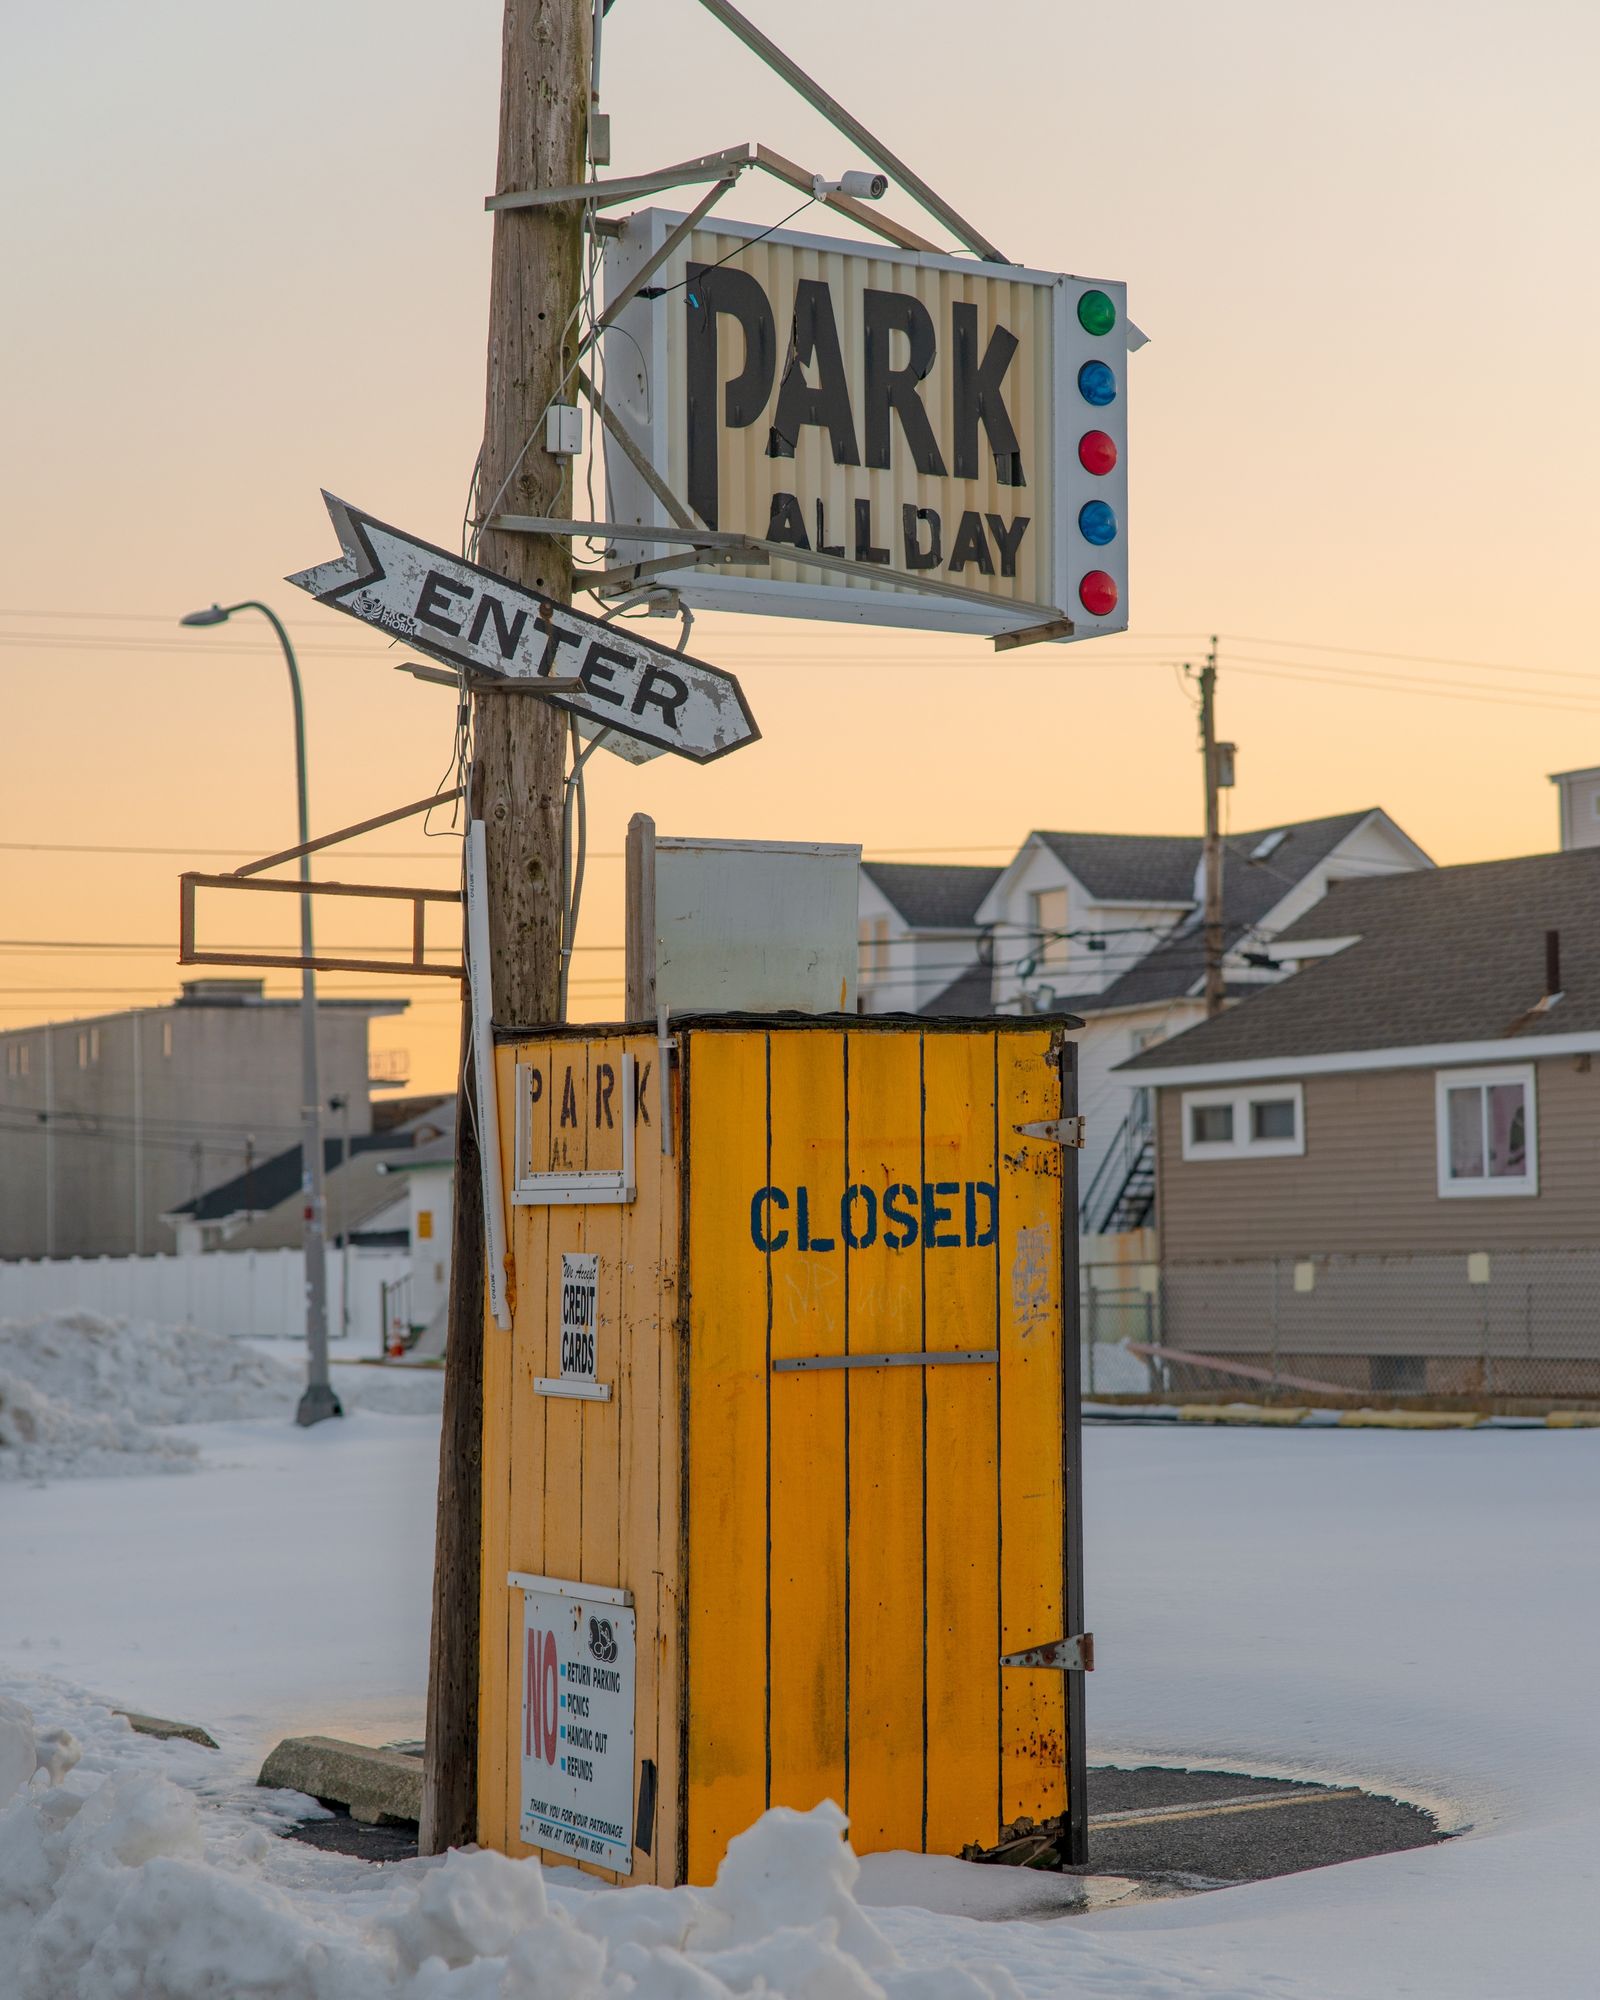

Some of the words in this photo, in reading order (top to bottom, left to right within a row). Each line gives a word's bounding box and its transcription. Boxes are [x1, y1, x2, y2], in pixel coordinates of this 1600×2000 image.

[686, 261, 1027, 531] PARK
[380, 614, 414, 636] PHOBIA
[414, 570, 689, 729] ENTER
[750, 1181, 998, 1252] CLOSED
[563, 1262, 574, 1279] We
[575, 1264, 597, 1284] Accept
[563, 1284, 596, 1327] CREDIT
[562, 1331, 594, 1375] CARDS
[567, 1661, 591, 1687] RETURN
[592, 1667, 621, 1693] PARKING
[525, 1627, 558, 1766] NO
[567, 1693, 590, 1718] PICNICS
[567, 1724, 593, 1751] HANGING
[594, 1731, 608, 1754] OUT
[567, 1755, 593, 1783] REFUNDS
[530, 1798, 549, 1815] THANK
[549, 1804, 561, 1818] YOU
[561, 1808, 573, 1823] FOR
[573, 1812, 588, 1828] YOUR
[588, 1818, 624, 1839] PATRONAGE
[538, 1823, 554, 1838] PARK
[554, 1828, 562, 1841] AT
[576, 1836, 590, 1851] OWN
[590, 1840, 605, 1855] RISK
